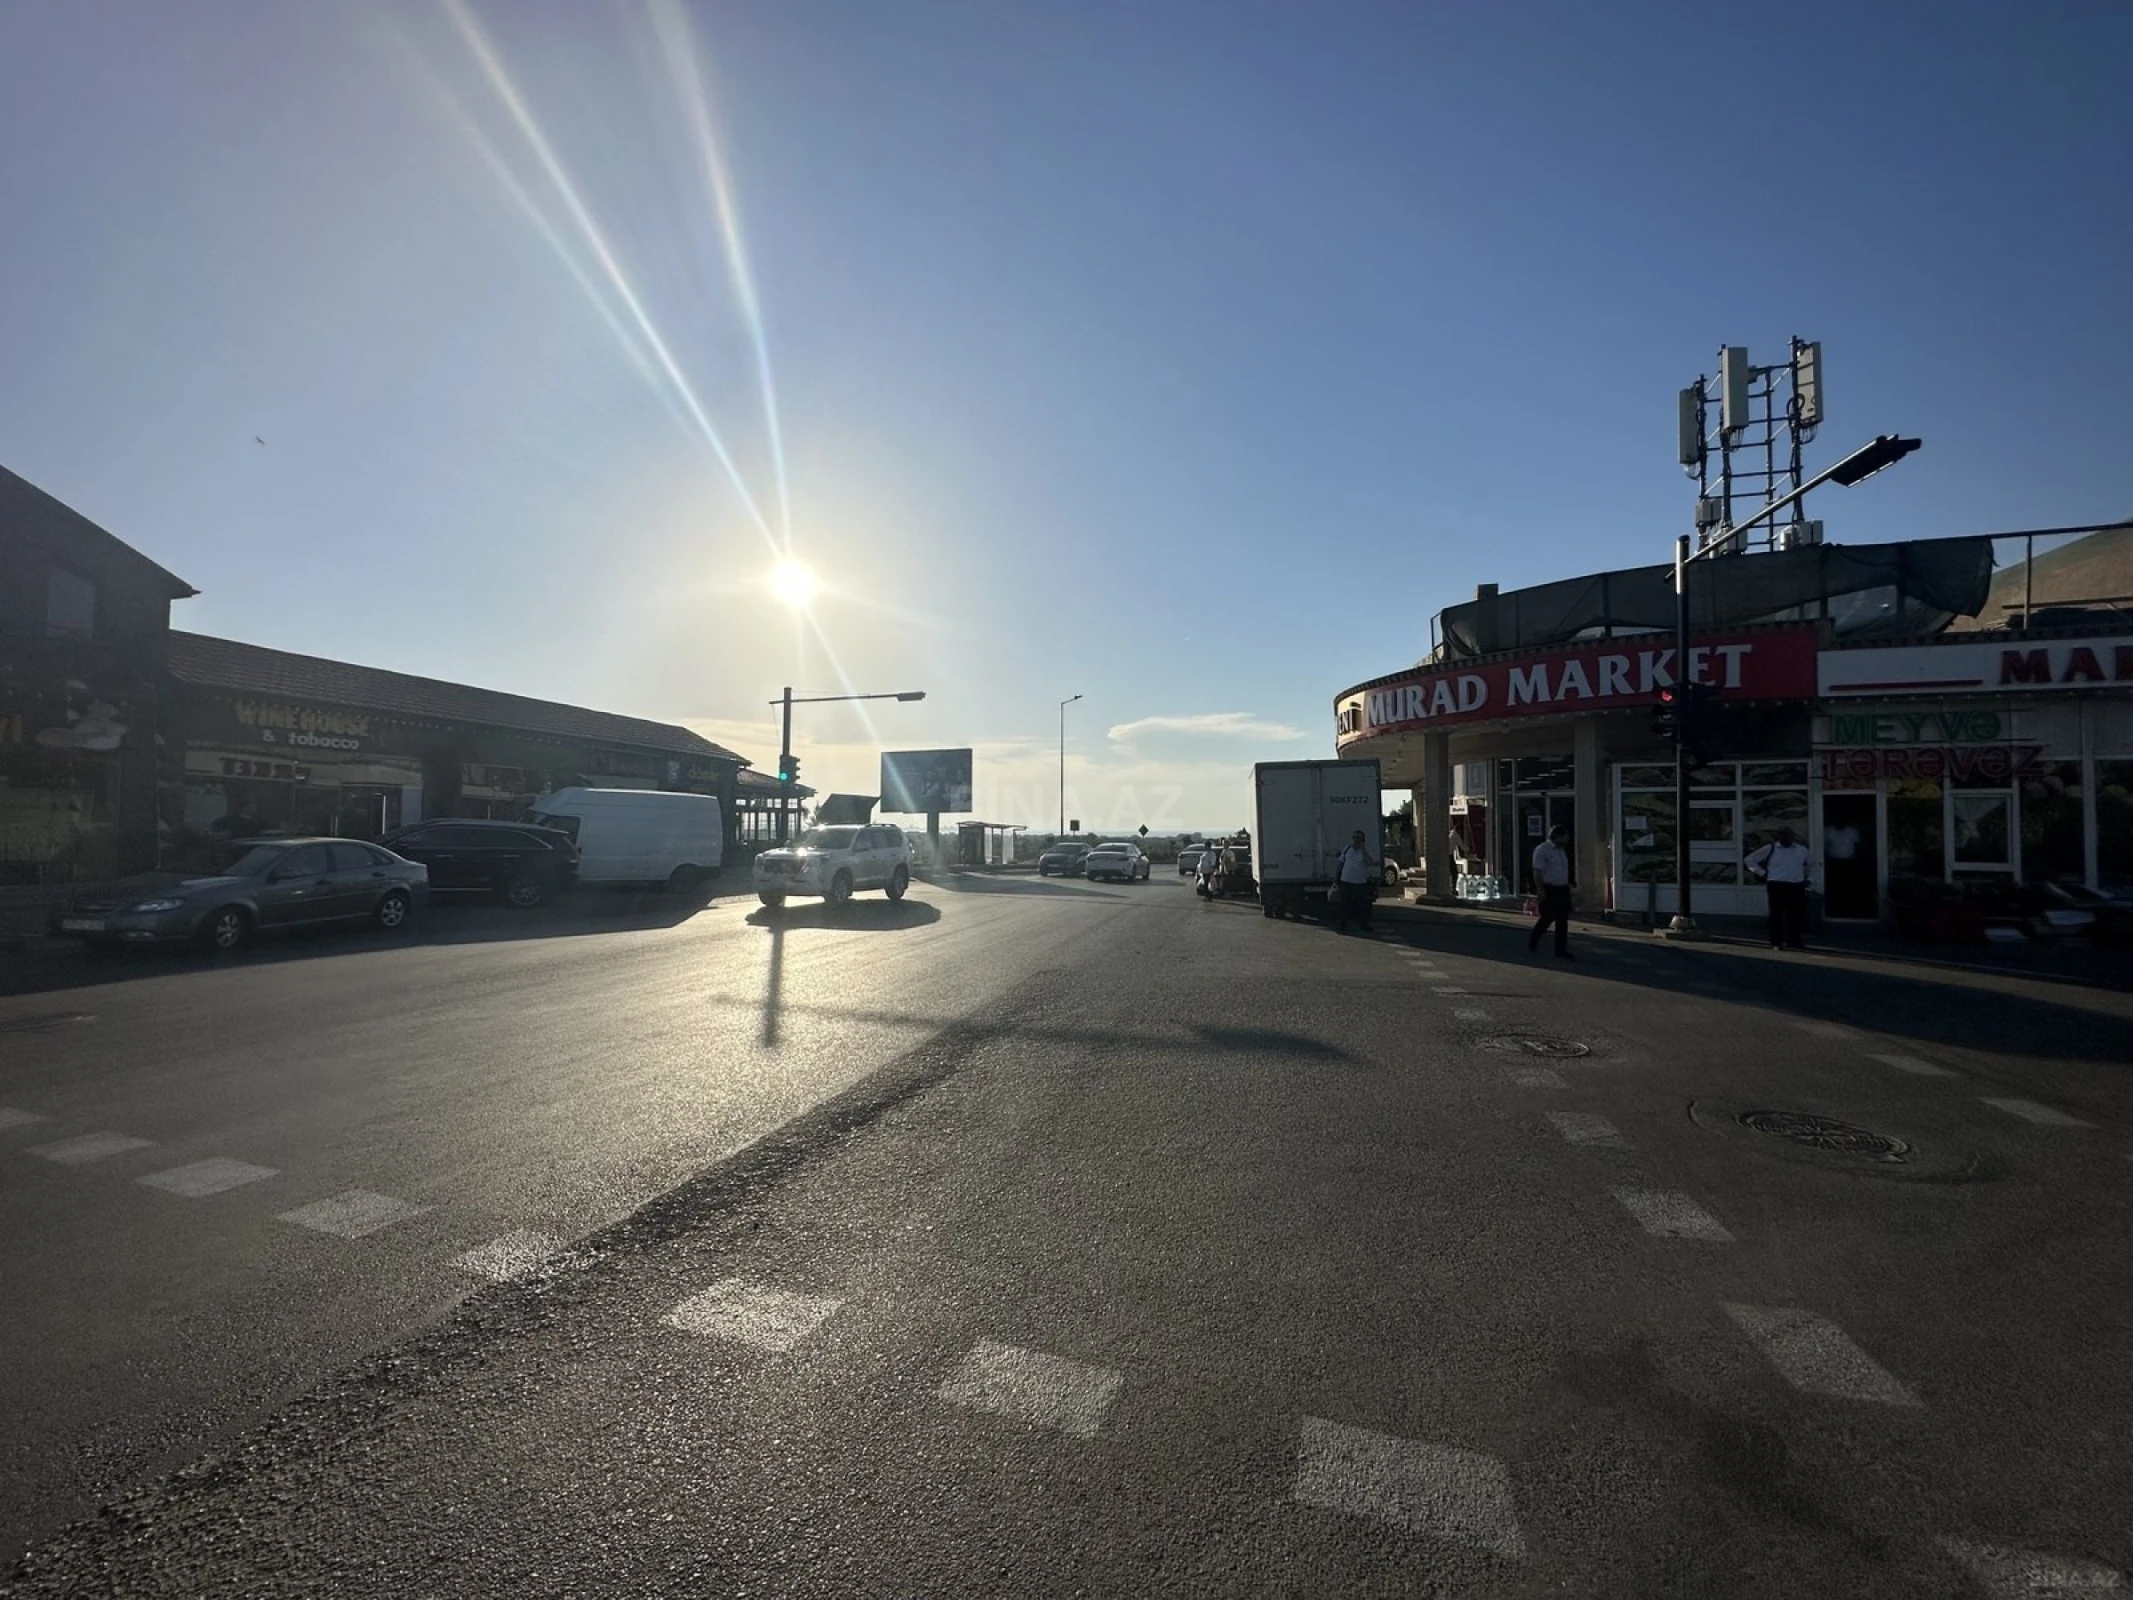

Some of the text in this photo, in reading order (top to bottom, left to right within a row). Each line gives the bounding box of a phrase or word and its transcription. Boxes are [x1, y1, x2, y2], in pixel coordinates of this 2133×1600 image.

[1365, 674, 1489, 728] MURAD
[1507, 643, 1752, 707] MARKET
[262, 729, 360, 750] & tobacco
[1832, 710, 2002, 745] MEYVƏ
